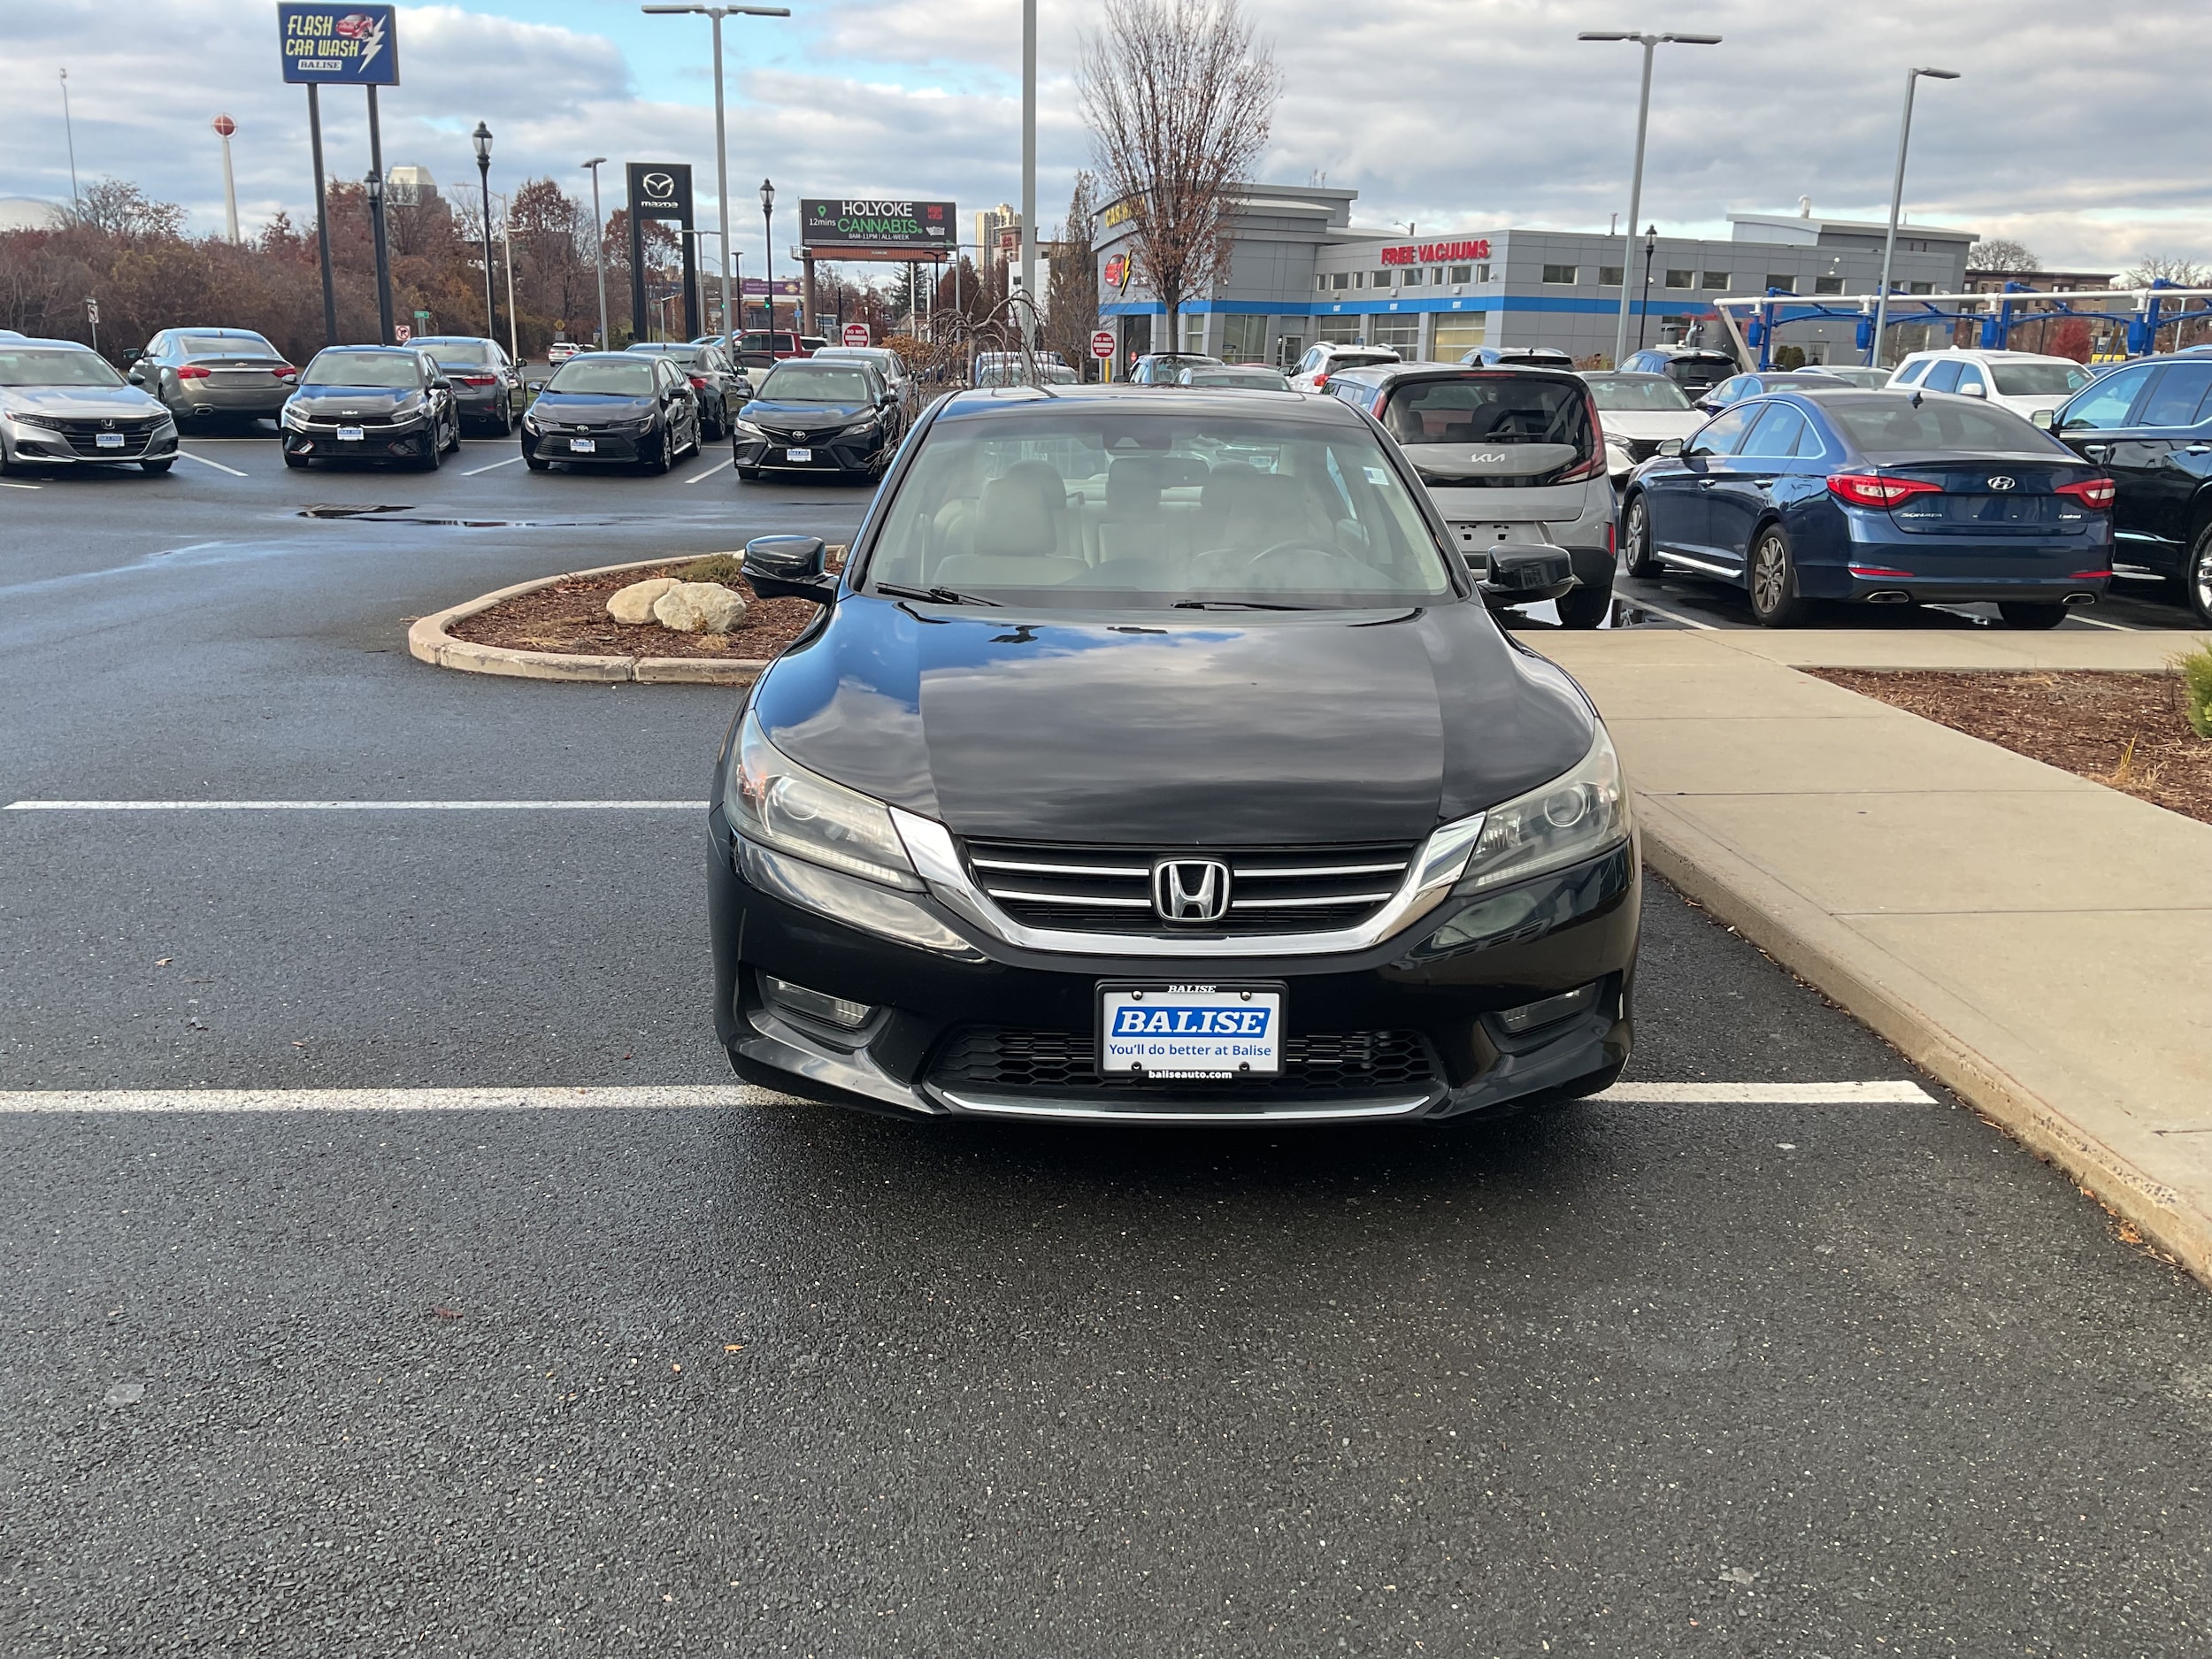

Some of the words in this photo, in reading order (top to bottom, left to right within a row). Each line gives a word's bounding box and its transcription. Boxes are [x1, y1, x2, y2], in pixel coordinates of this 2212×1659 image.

[288, 14, 333, 36] FLASH
[285, 39, 314, 57] CAR
[318, 40, 359, 57] WASH
[842, 202, 912, 217] HOLYOKE
[1106, 205, 1120, 227] CAR
[809, 218, 836, 227] 12mins
[1381, 246, 1414, 265] FREE
[1418, 240, 1490, 261] VACUUMS
[1168, 985, 1217, 994] BALISE
[1118, 1010, 1265, 1033] BALISE
[1148, 1044, 1164, 1055] do
[1170, 1045, 1210, 1055] better
[1215, 1046, 1228, 1055] at
[1233, 1045, 1271, 1056] Balise
